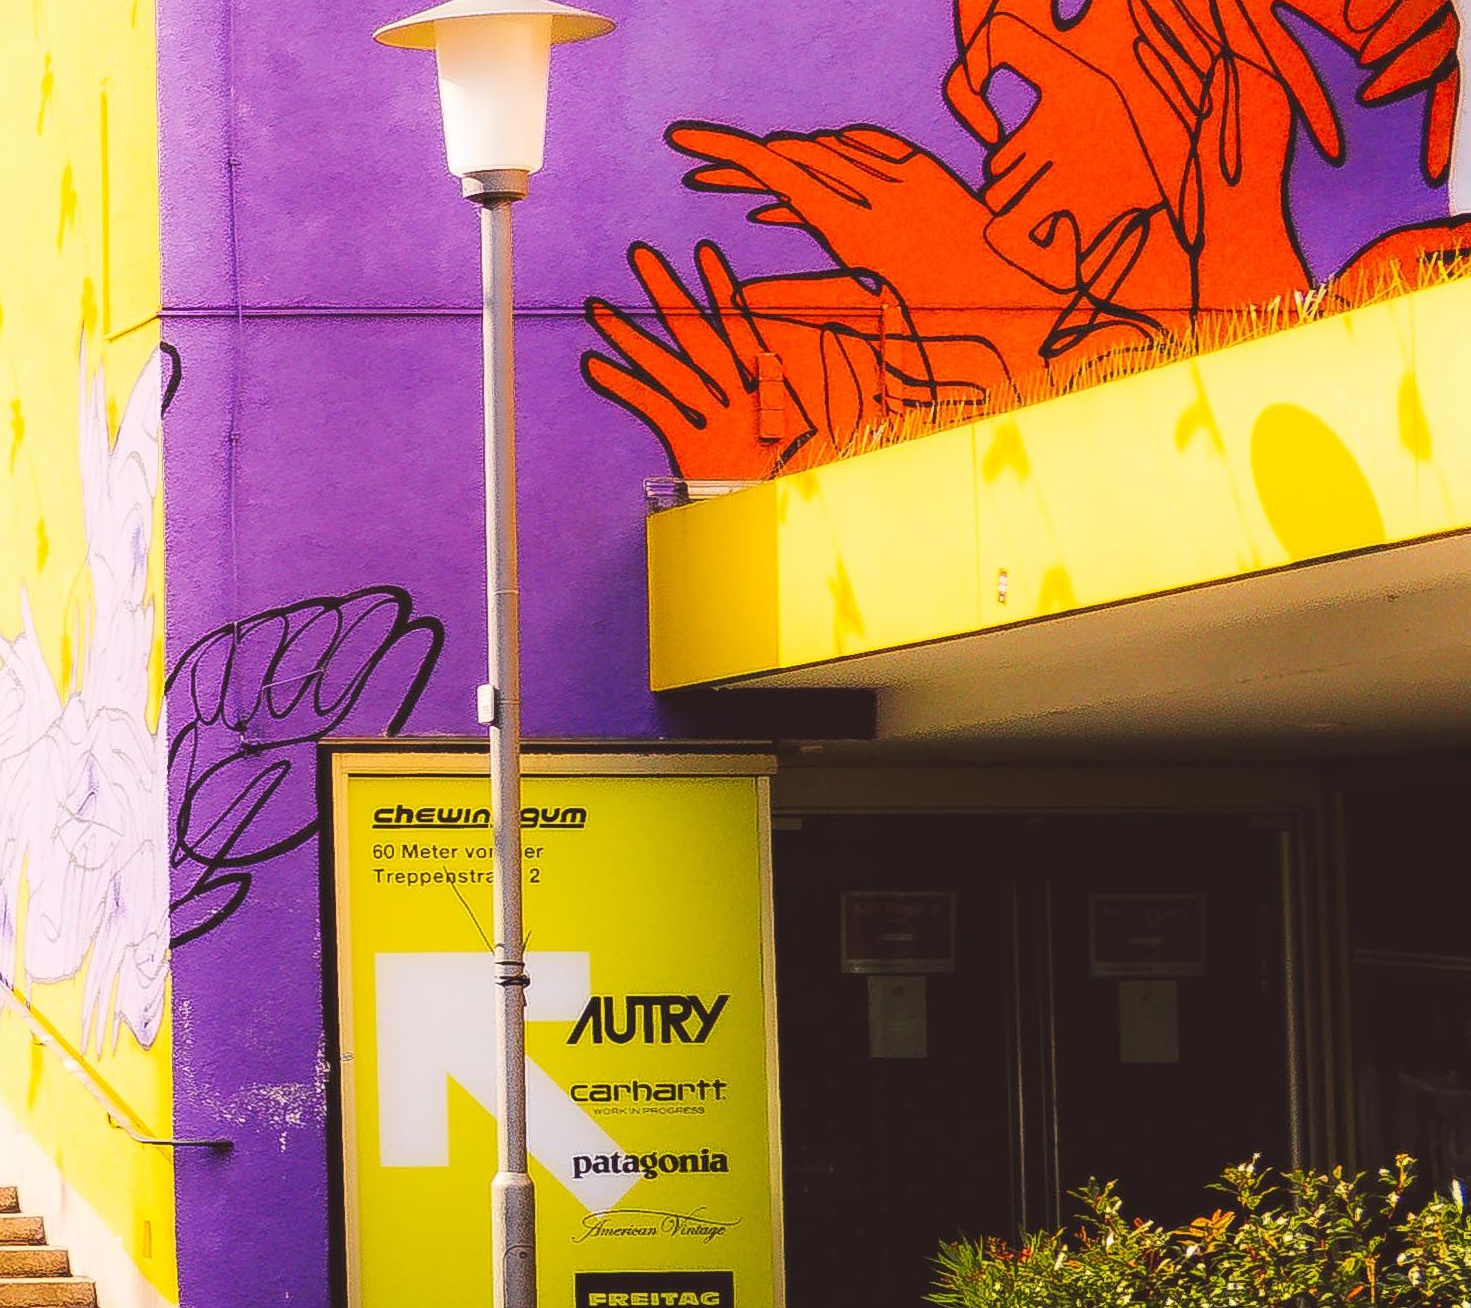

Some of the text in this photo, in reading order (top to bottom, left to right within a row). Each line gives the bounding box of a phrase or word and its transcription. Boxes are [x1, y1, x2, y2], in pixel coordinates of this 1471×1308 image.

[373, 804, 494, 829] chewin
[373, 844, 395, 859] 60
[401, 844, 458, 859] Meter
[529, 869, 541, 883] 2
[565, 995, 731, 1044] AUTRY
[570, 1079, 727, 1102] carhartt
[593, 1107, 626, 1115] WORK
[643, 1106, 706, 1115] PROGRESS
[572, 1148, 730, 1180] patagonia
[572, 1207, 728, 1244] American Vintage
[588, 1291, 720, 1307] FREITAG
